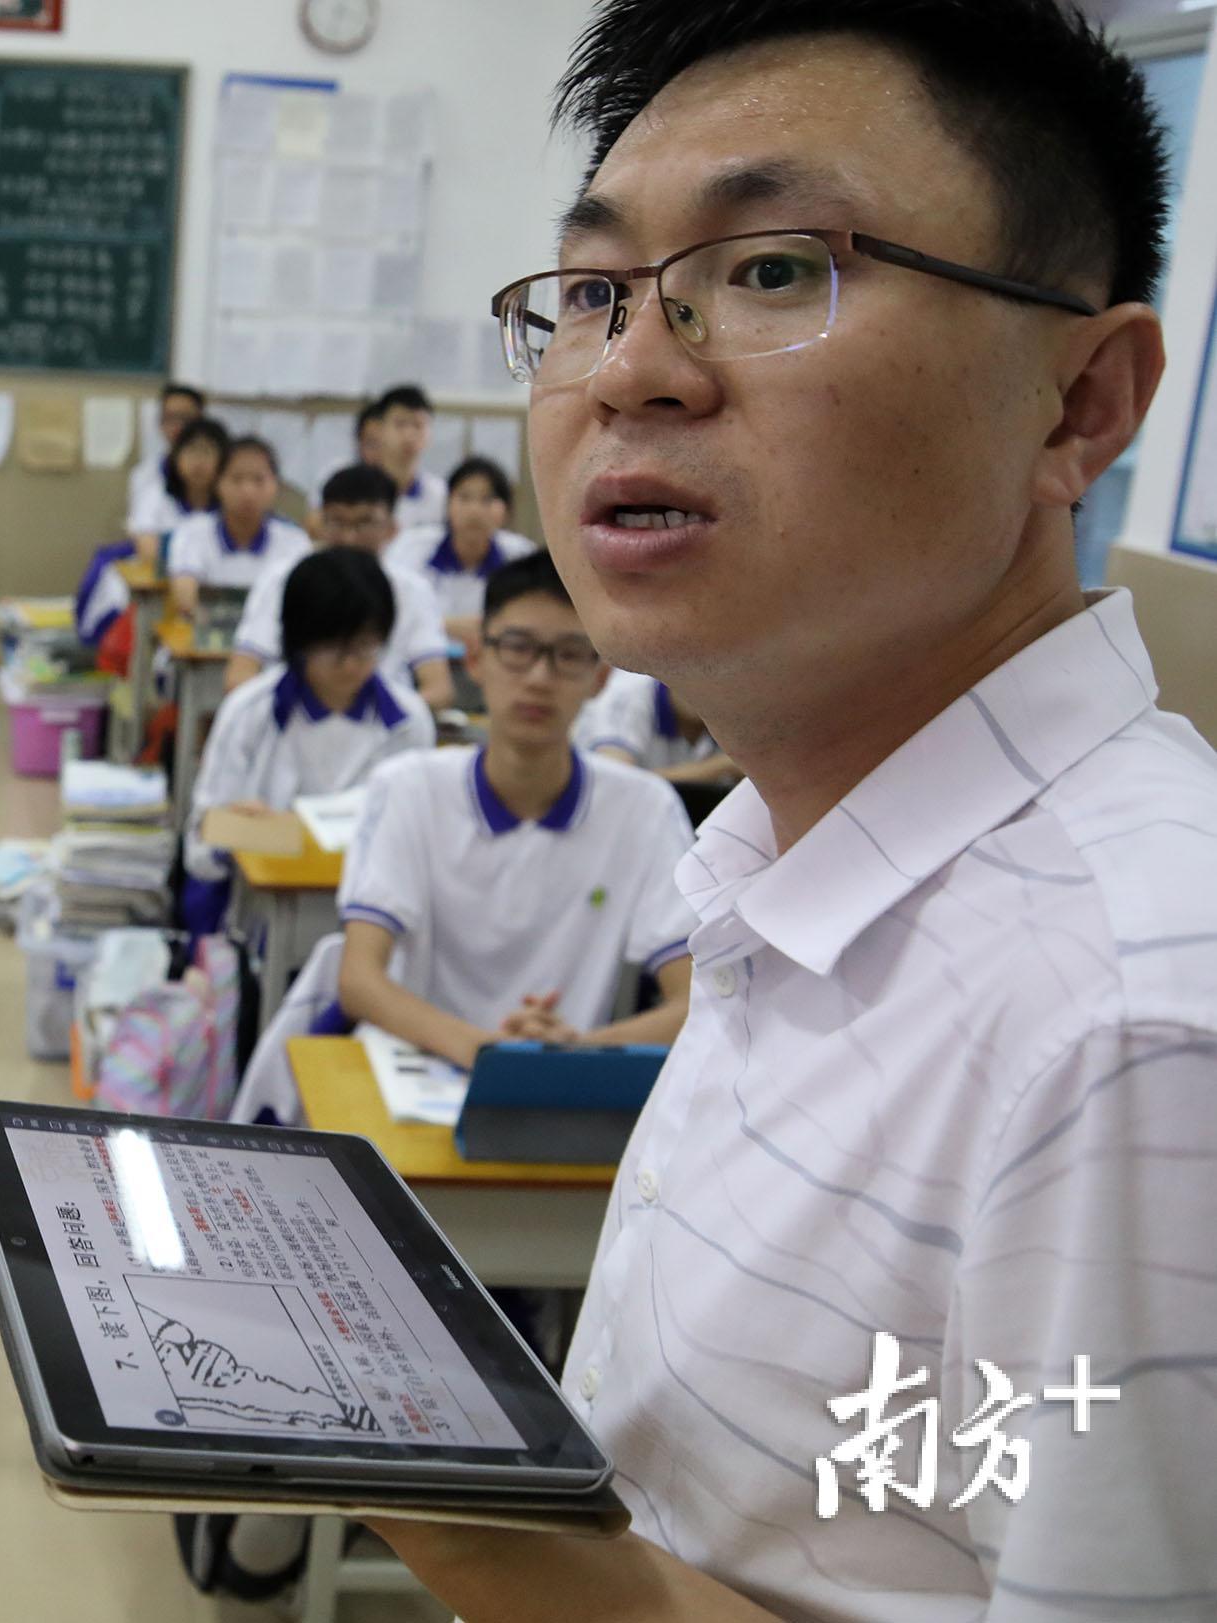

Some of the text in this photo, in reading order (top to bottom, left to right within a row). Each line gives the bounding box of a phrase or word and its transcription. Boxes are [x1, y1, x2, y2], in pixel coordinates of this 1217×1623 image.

[54, 1201, 140, 1370] 7、读下图，回答问题：
